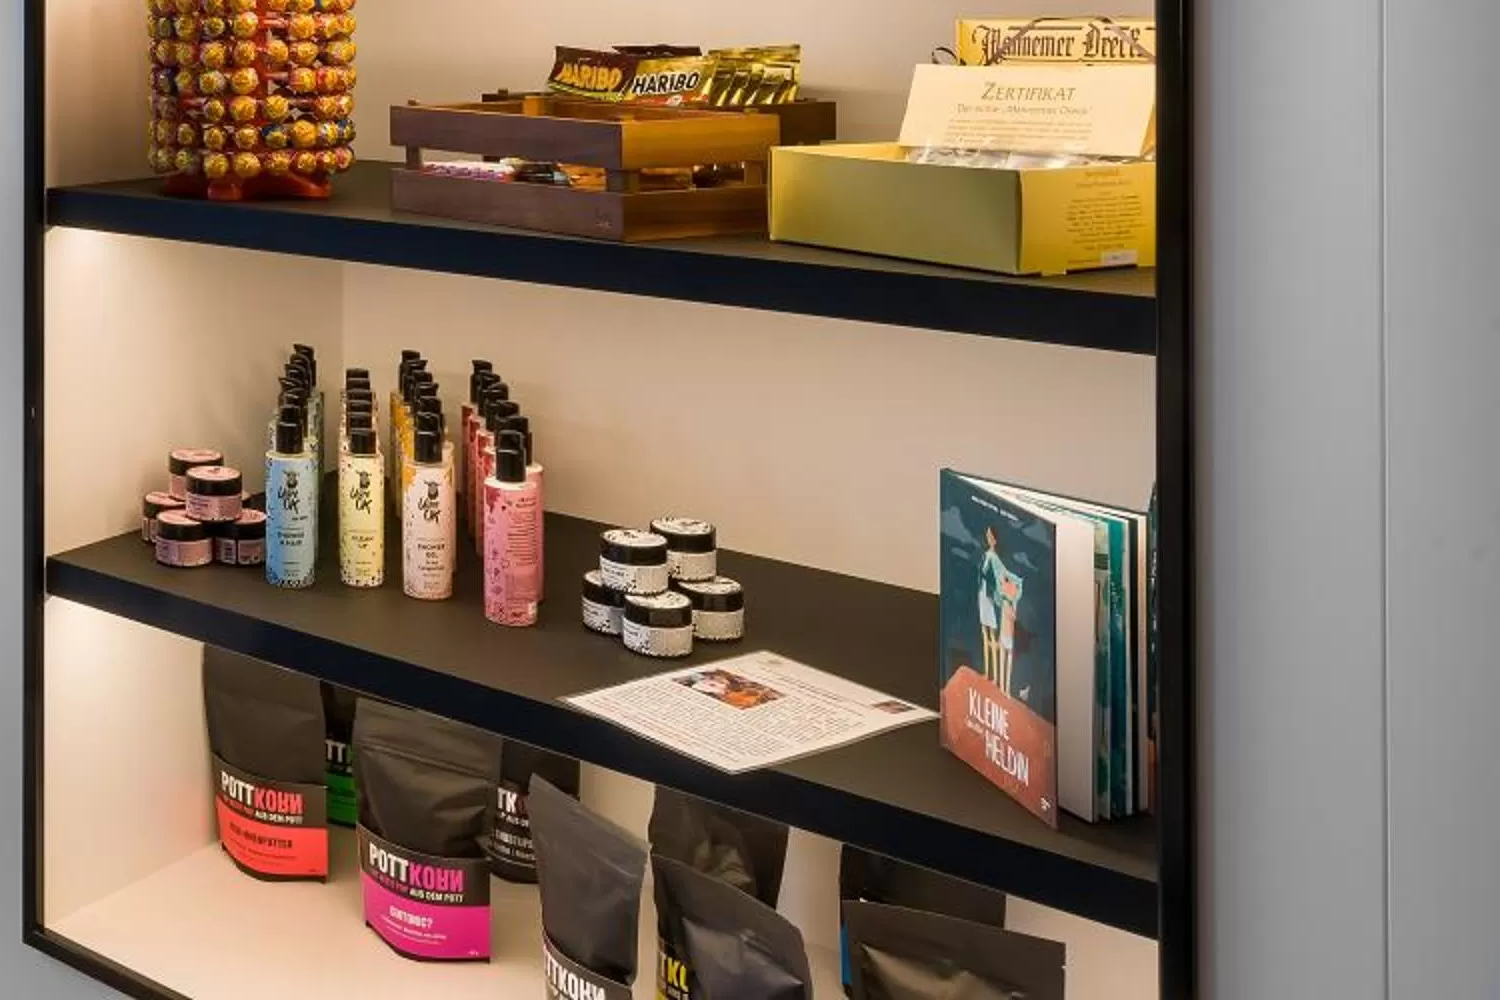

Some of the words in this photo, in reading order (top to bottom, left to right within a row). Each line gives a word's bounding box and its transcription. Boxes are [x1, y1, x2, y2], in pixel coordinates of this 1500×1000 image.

[554, 61, 623, 90] HARIBO
[632, 71, 700, 96] HARIBO
[980, 81, 1077, 102] ZERTIFIKAT
[968, 686, 1011, 742] KLEINE
[985, 729, 1030, 788] HELDIN
